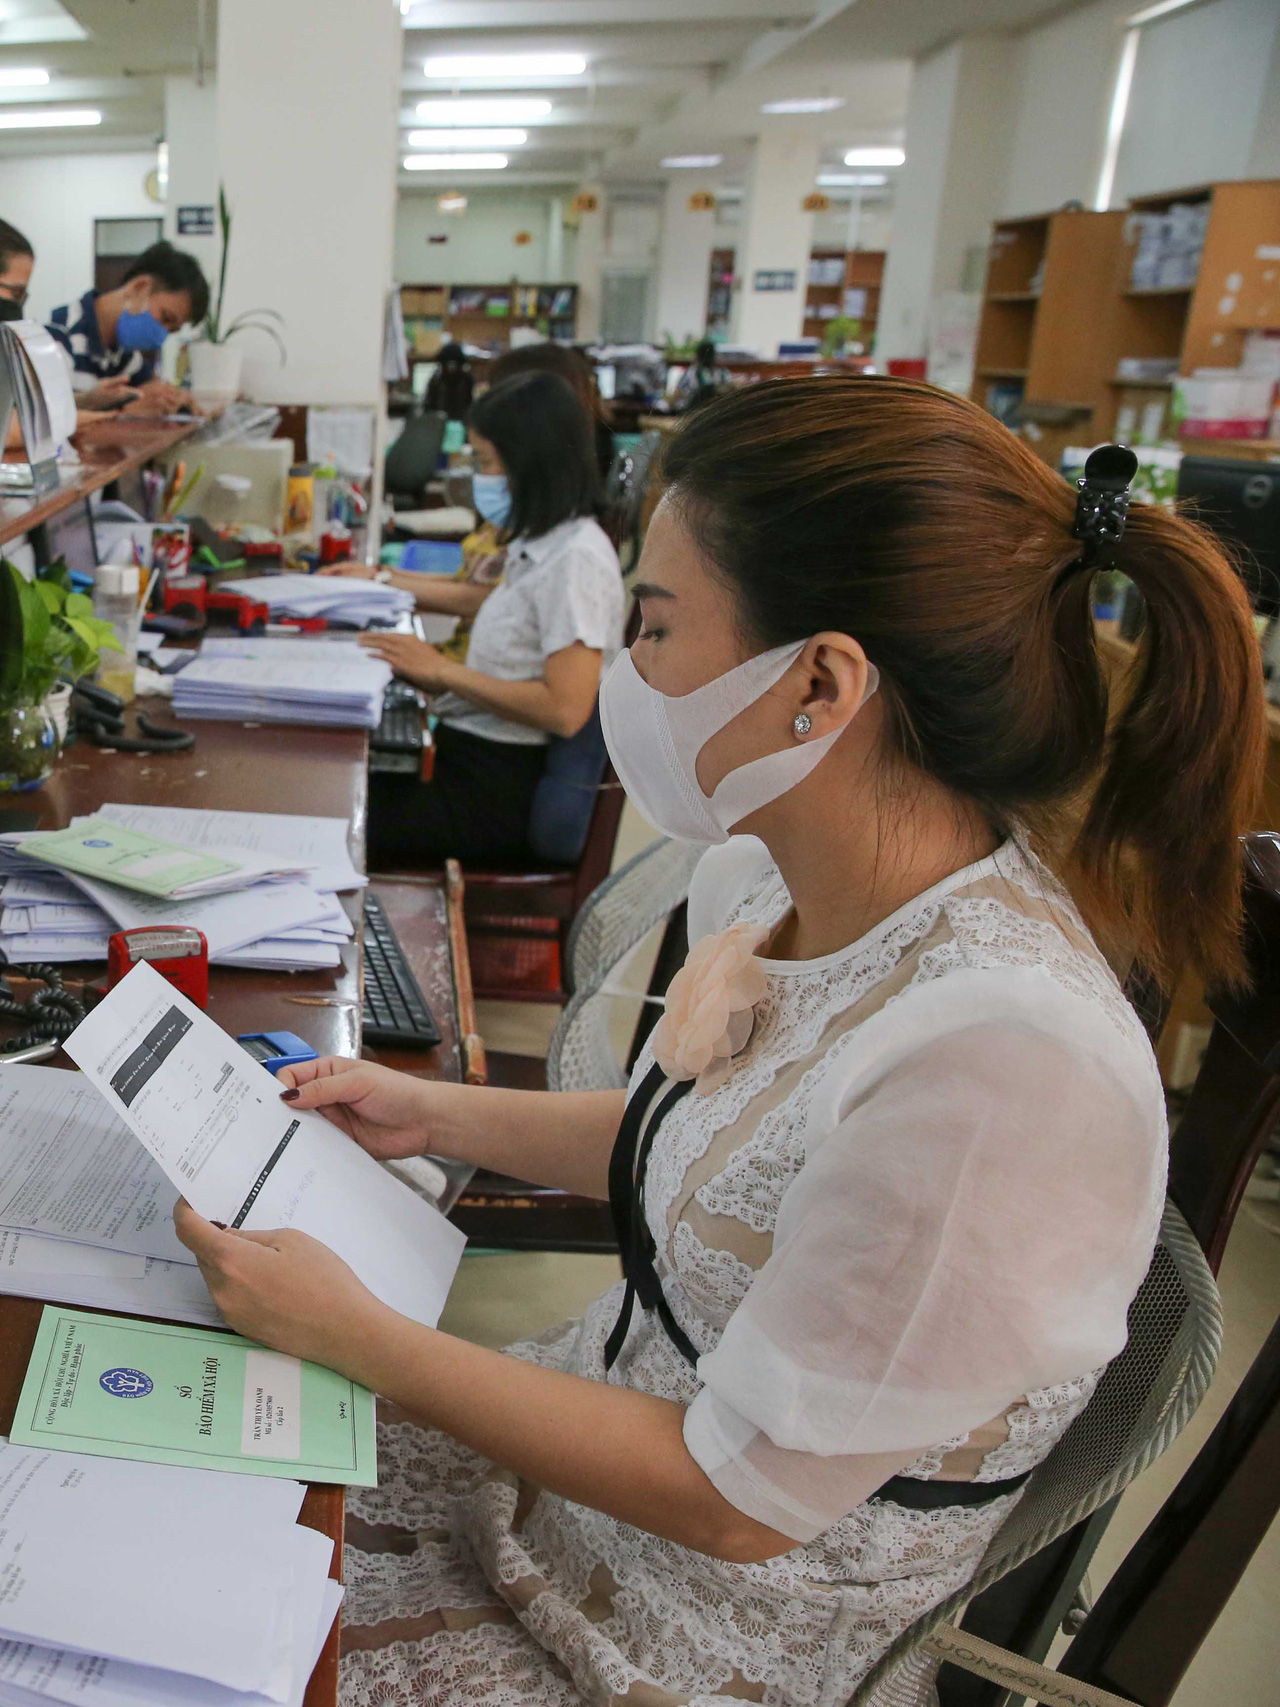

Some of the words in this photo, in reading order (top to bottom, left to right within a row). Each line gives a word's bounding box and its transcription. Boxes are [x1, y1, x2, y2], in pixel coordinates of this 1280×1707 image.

[203, 1357, 221, 1375] HỘI
[202, 1375, 216, 1389] XÃ
[174, 1385, 193, 1399] SỔ
[196, 1390, 215, 1415] HIỂM
[195, 1415, 212, 1436] BẢO
